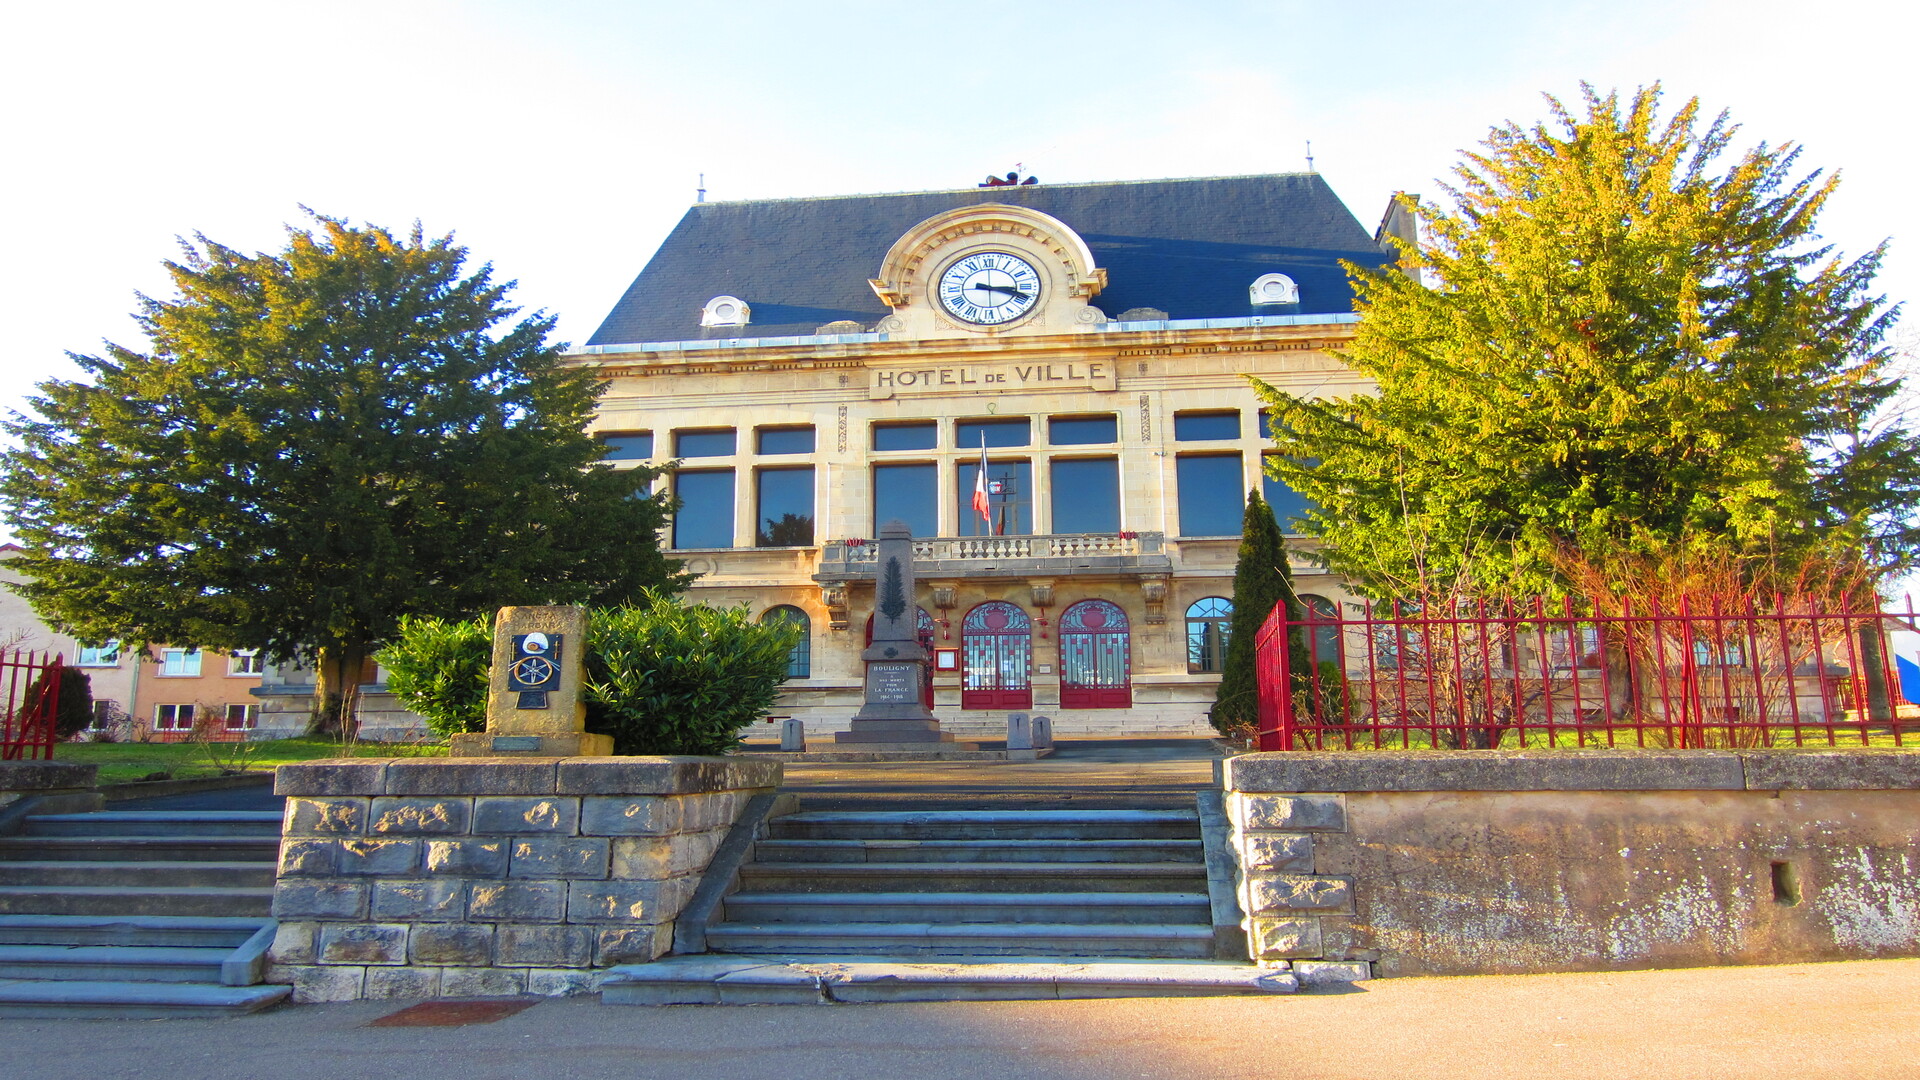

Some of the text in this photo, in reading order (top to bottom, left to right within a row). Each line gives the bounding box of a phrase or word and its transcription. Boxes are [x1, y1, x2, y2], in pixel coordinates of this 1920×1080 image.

[878, 364, 1106, 387] HOTEL DE VILLE
